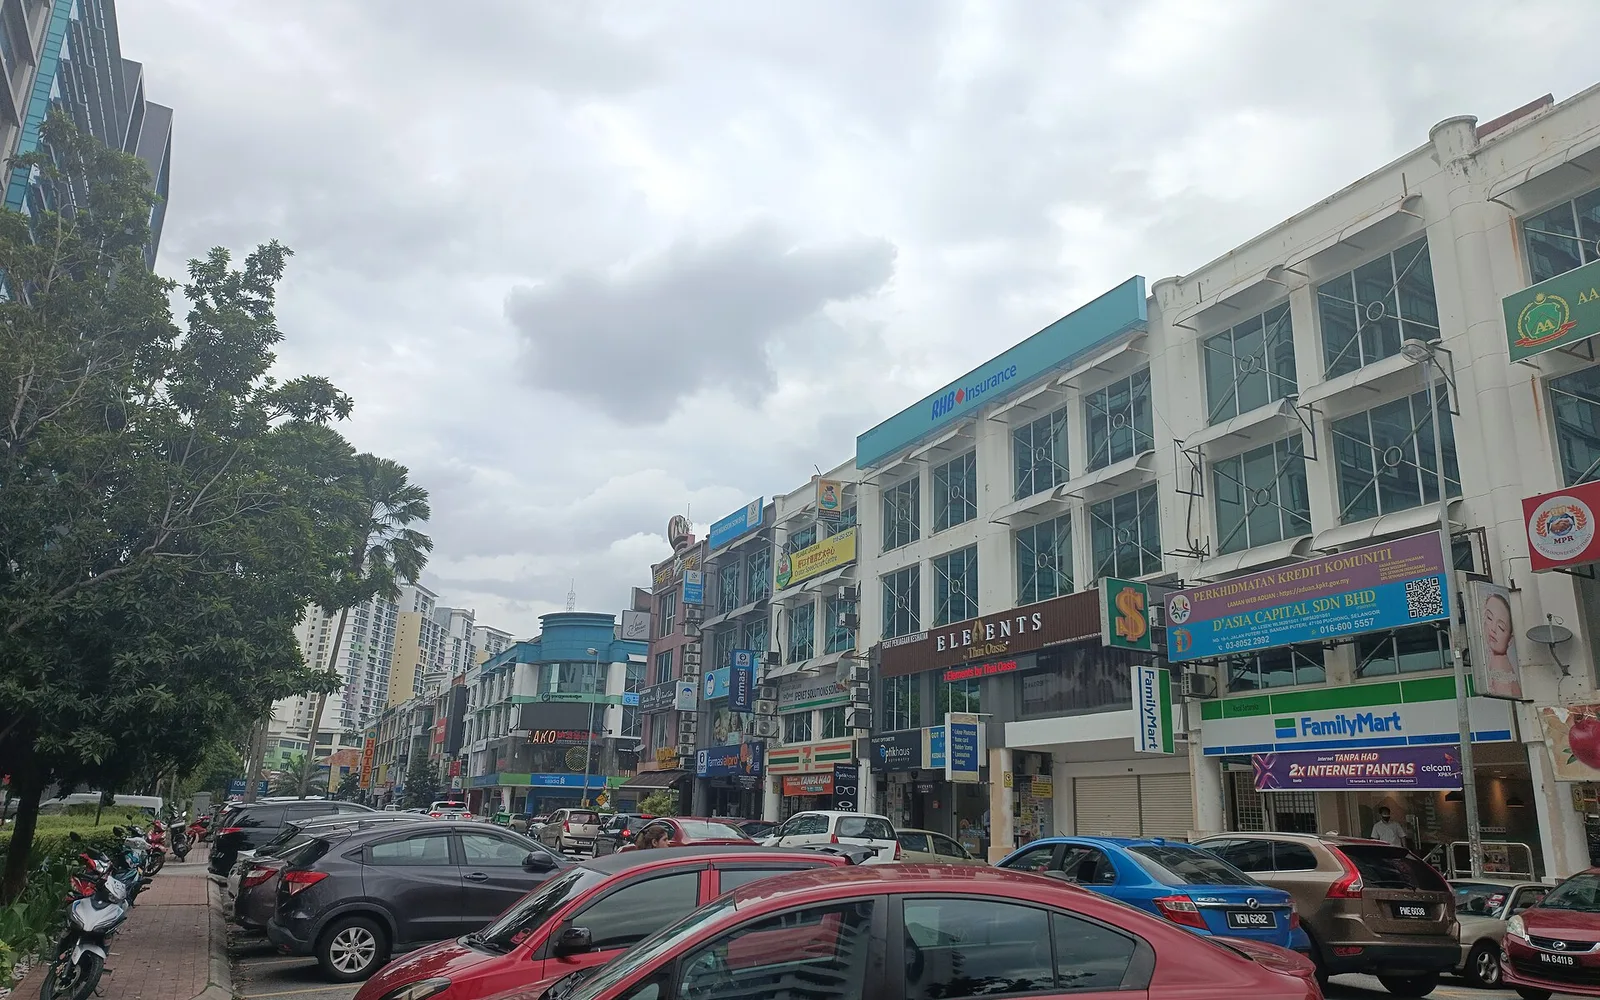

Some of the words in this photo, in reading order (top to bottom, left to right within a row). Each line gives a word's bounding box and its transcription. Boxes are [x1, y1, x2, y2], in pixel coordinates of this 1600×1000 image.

[931, 390, 955, 421] RHB
[965, 364, 1017, 402] Insurance
[1553, 535, 1574, 545] MPR
[1194, 576, 1275, 602] PERKHIDMATAN
[1278, 564, 1323, 585] KREDIT
[1324, 548, 1392, 573] KOMUNITI
[1227, 600, 1245, 608] LAMAN
[1257, 593, 1276, 602] ADUAN
[1213, 614, 1252, 632] D'ASIA
[1255, 603, 1310, 623] CAPITAL
[1312, 596, 1341, 613] SDN
[1344, 590, 1376, 607] BHD
[1269, 626, 1289, 634] BANDAR
[1351, 609, 1381, 619] SELANGOR
[1320, 621, 1352, 634] 016-600
[1354, 618, 1374, 628] 5557
[967, 644, 984, 659] Thai
[985, 641, 1007, 654] Oasis
[1225, 640, 1252, 650] 03-8052
[1253, 636, 1270, 645] 2992
[947, 668, 974, 681] Elements
[974, 666, 982, 676] by
[983, 663, 997, 674] Thai
[998, 660, 1017, 671] Oasis
[735, 668, 746, 706] farmasi
[1144, 670, 1158, 749] FamilyMart
[1300, 711, 1402, 737] FamilyMart
[707, 755, 723, 767] farmasi
[1335, 753, 1359, 762] TANPA
[1361, 752, 1379, 762] HAD
[1289, 763, 1305, 777] 2x
[1306, 764, 1364, 777] INTERNET
[1365, 762, 1415, 776] PANTAS
[1421, 764, 1451, 772] celcom
[800, 776, 818, 785] TANPA
[1235, 913, 1250, 924] VEN
